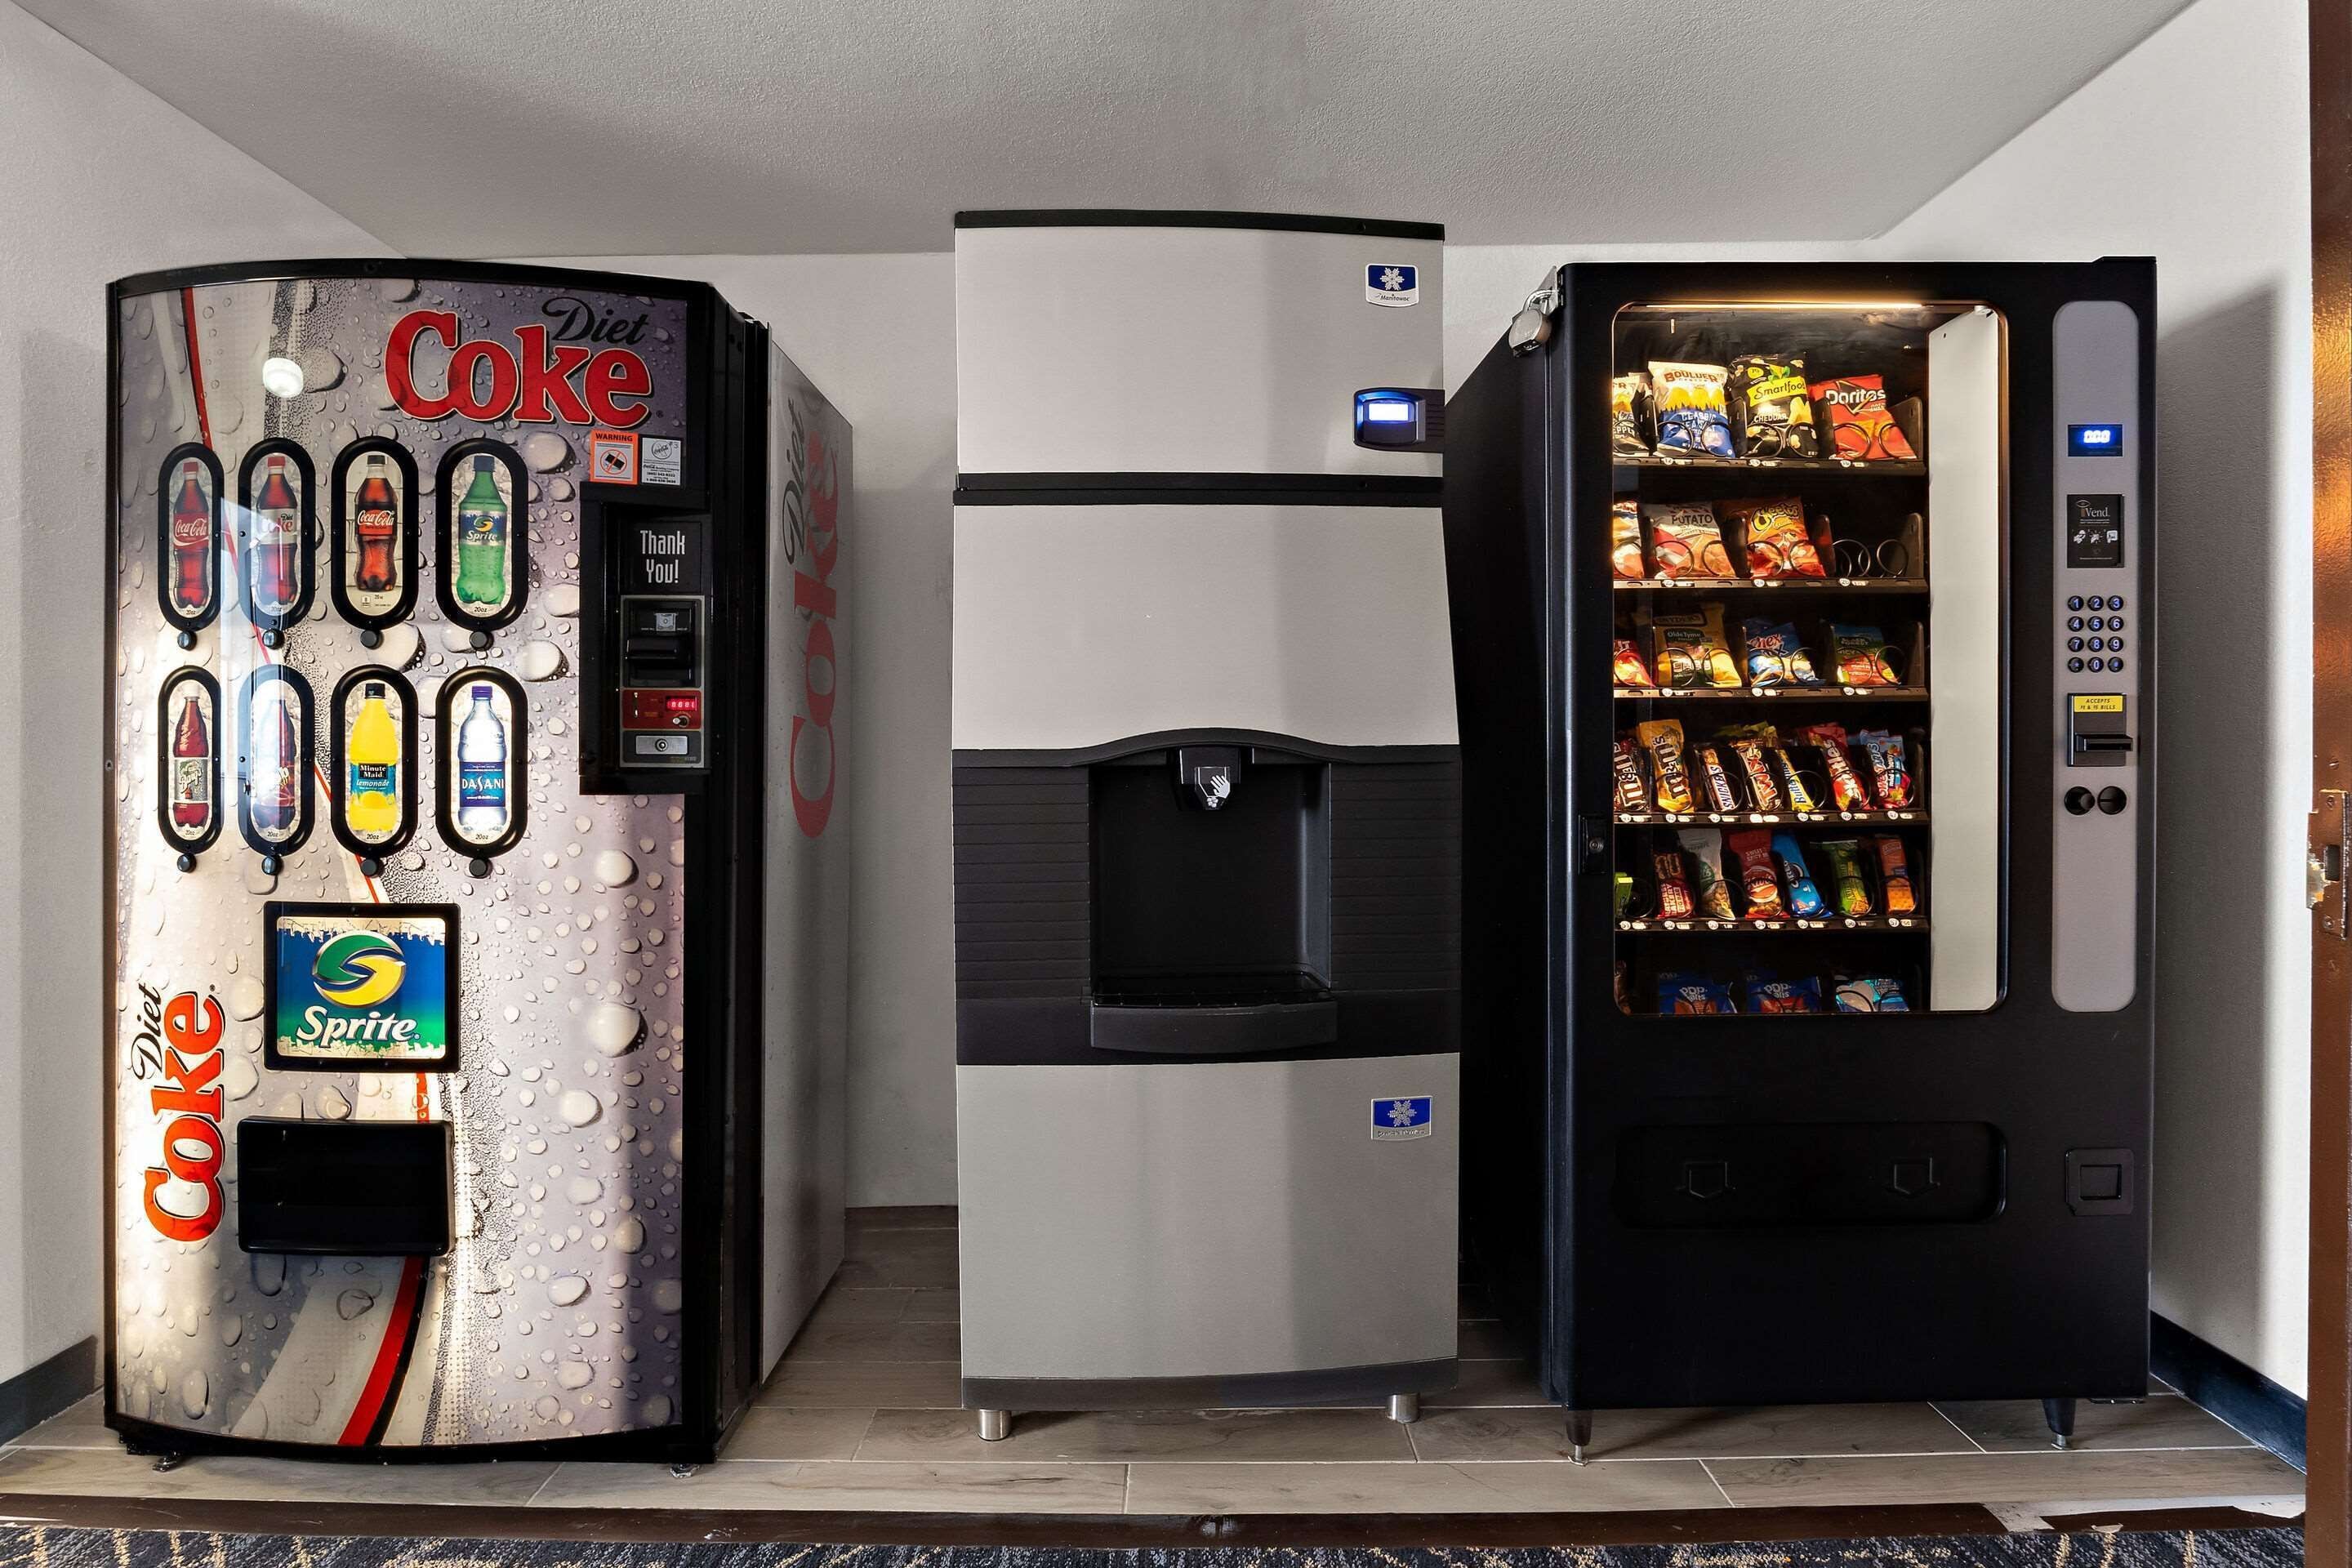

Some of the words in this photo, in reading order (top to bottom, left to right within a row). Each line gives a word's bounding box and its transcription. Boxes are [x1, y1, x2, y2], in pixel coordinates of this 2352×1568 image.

[542, 296, 650, 346] Diet
[384, 310, 654, 428] Coke
[1825, 389, 1886, 405] Doritos
[1754, 414, 1789, 423] CHEDDAR
[595, 432, 634, 443] WARNING
[784, 398, 807, 565] Diet
[358, 510, 395, 527] Coca-Cola
[1671, 514, 1713, 524] POTATO
[175, 517, 208, 537] Coca-Cola
[466, 530, 498, 542] Sprite
[640, 530, 686, 555] Thank
[646, 559, 679, 584] You!
[2073, 599, 2079, 608] 1
[2093, 599, 2100, 608] 2
[2114, 599, 2120, 608] 3
[2073, 619, 2080, 629] 4
[2093, 619, 2100, 629] 5
[2113, 619, 2120, 629] 6
[791, 430, 840, 839] Coke
[2073, 640, 2080, 649] 7
[2093, 640, 2100, 649] 8
[2113, 640, 2120, 649] 9
[2093, 660, 2100, 670] 0
[356, 779, 390, 787] Lemonade
[461, 777, 505, 792] DASANI
[131, 982, 164, 1080] Diet
[296, 1004, 419, 1049] Sprite
[144, 989, 226, 1242] Coke
